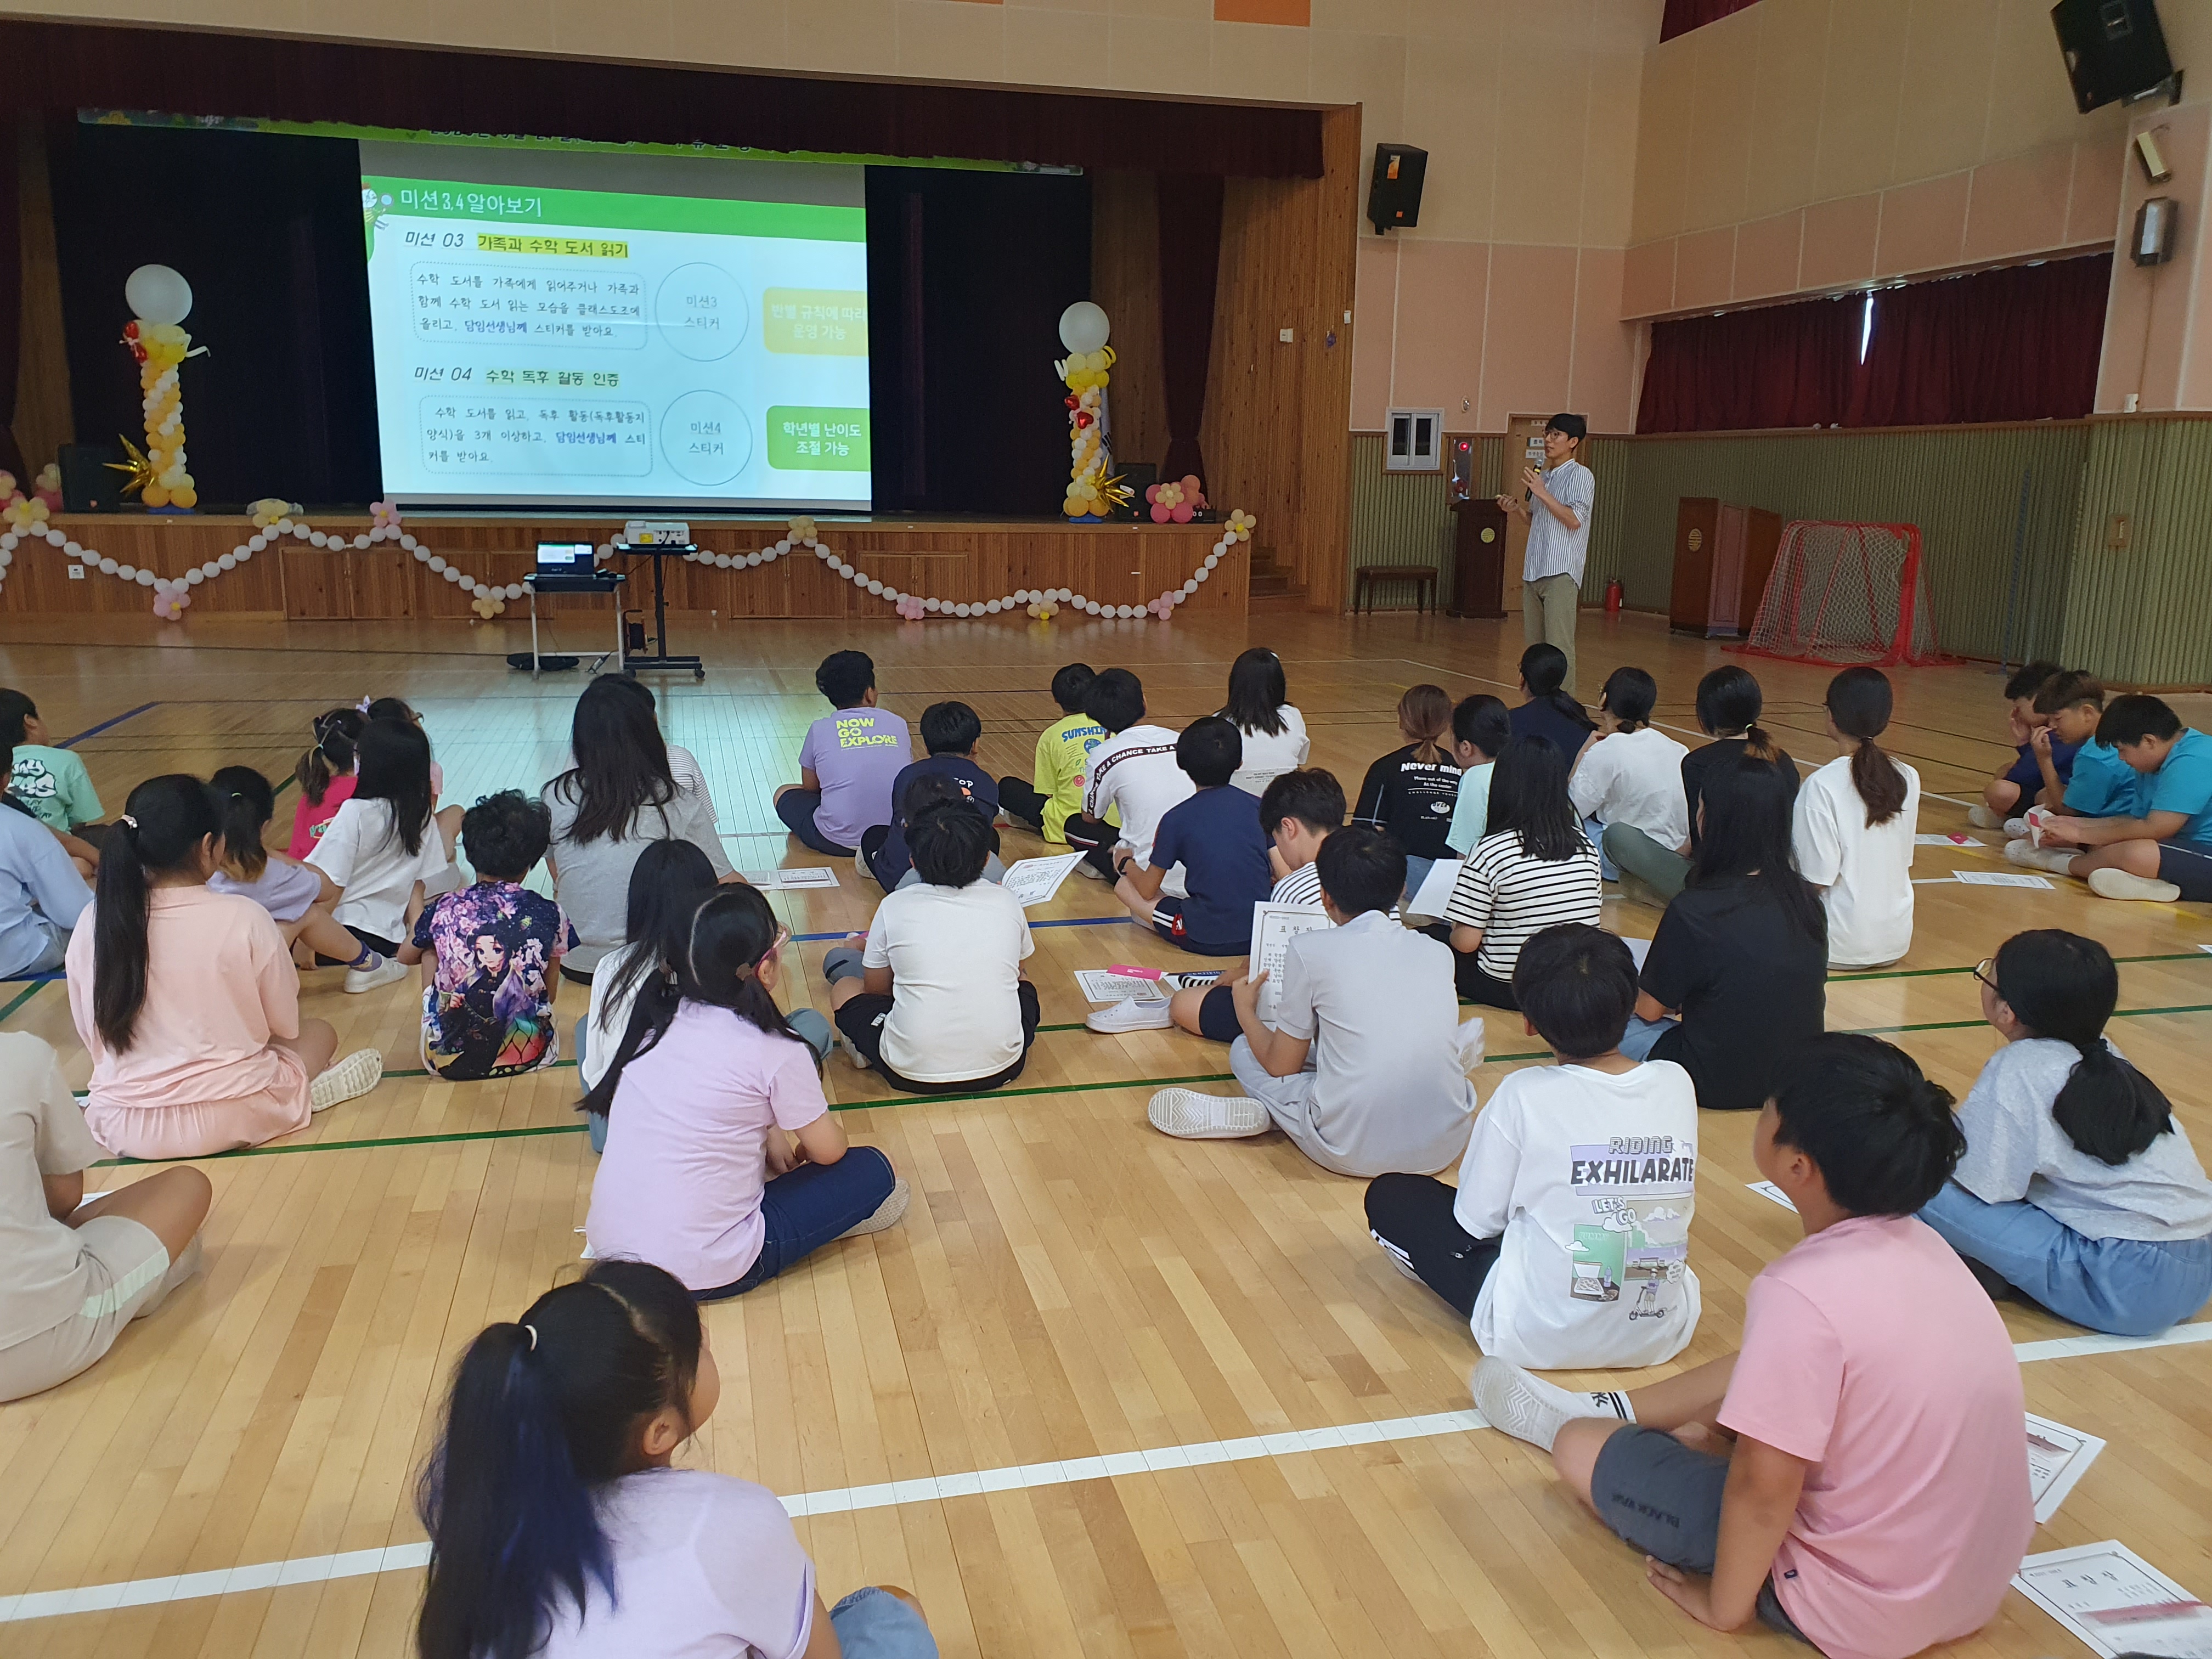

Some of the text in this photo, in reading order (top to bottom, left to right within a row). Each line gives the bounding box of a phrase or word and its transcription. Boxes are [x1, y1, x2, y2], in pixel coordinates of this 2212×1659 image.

[405, 232, 629, 258] 미션 03 가족과 수학 도서 읽기
[417, 273, 639, 295] 수학 도서를 가족에게 읽어주거나 가족과
[418, 295, 442, 308] 함께
[449, 297, 471, 309] 수학
[480, 298, 500, 311] 도서
[508, 300, 529, 312] 읽는
[537, 302, 569, 314] 모습을
[686, 295, 717, 308] 미션3
[772, 304, 867, 321] 반별 규칙에 따라
[465, 319, 527, 334] 담임선생님께
[534, 323, 575, 336] 스티커를
[685, 317, 720, 330] 스티커
[793, 324, 847, 340] 운영 가능
[414, 367, 619, 387] 미션 04 수학 독후 활동 인증
[435, 407, 456, 419] 수학
[466, 408, 496, 420] 도서를
[539, 409, 559, 421] 독후
[690, 421, 721, 434] 미션4
[782, 421, 862, 438] 학년별 난이도
[475, 430, 491, 441] 3개
[556, 431, 617, 444] 담임선생님께
[625, 433, 645, 444] 스티
[428, 450, 449, 462] 커를
[689, 442, 724, 455] 스티커
[795, 441, 850, 456] 조절 가능
[836, 718, 874, 729] NOW
[838, 727, 862, 737] GO
[840, 735, 898, 747] EXPLORE
[1111, 749, 1143, 763] CHANCE
[1401, 763, 1437, 772] Never
[1609, 1136, 1673, 1155] RIDING
[1570, 1158, 1694, 1184] EXHILARATE
[1592, 1197, 1624, 1214] LET'S
[1617, 1208, 1637, 1225] GO
